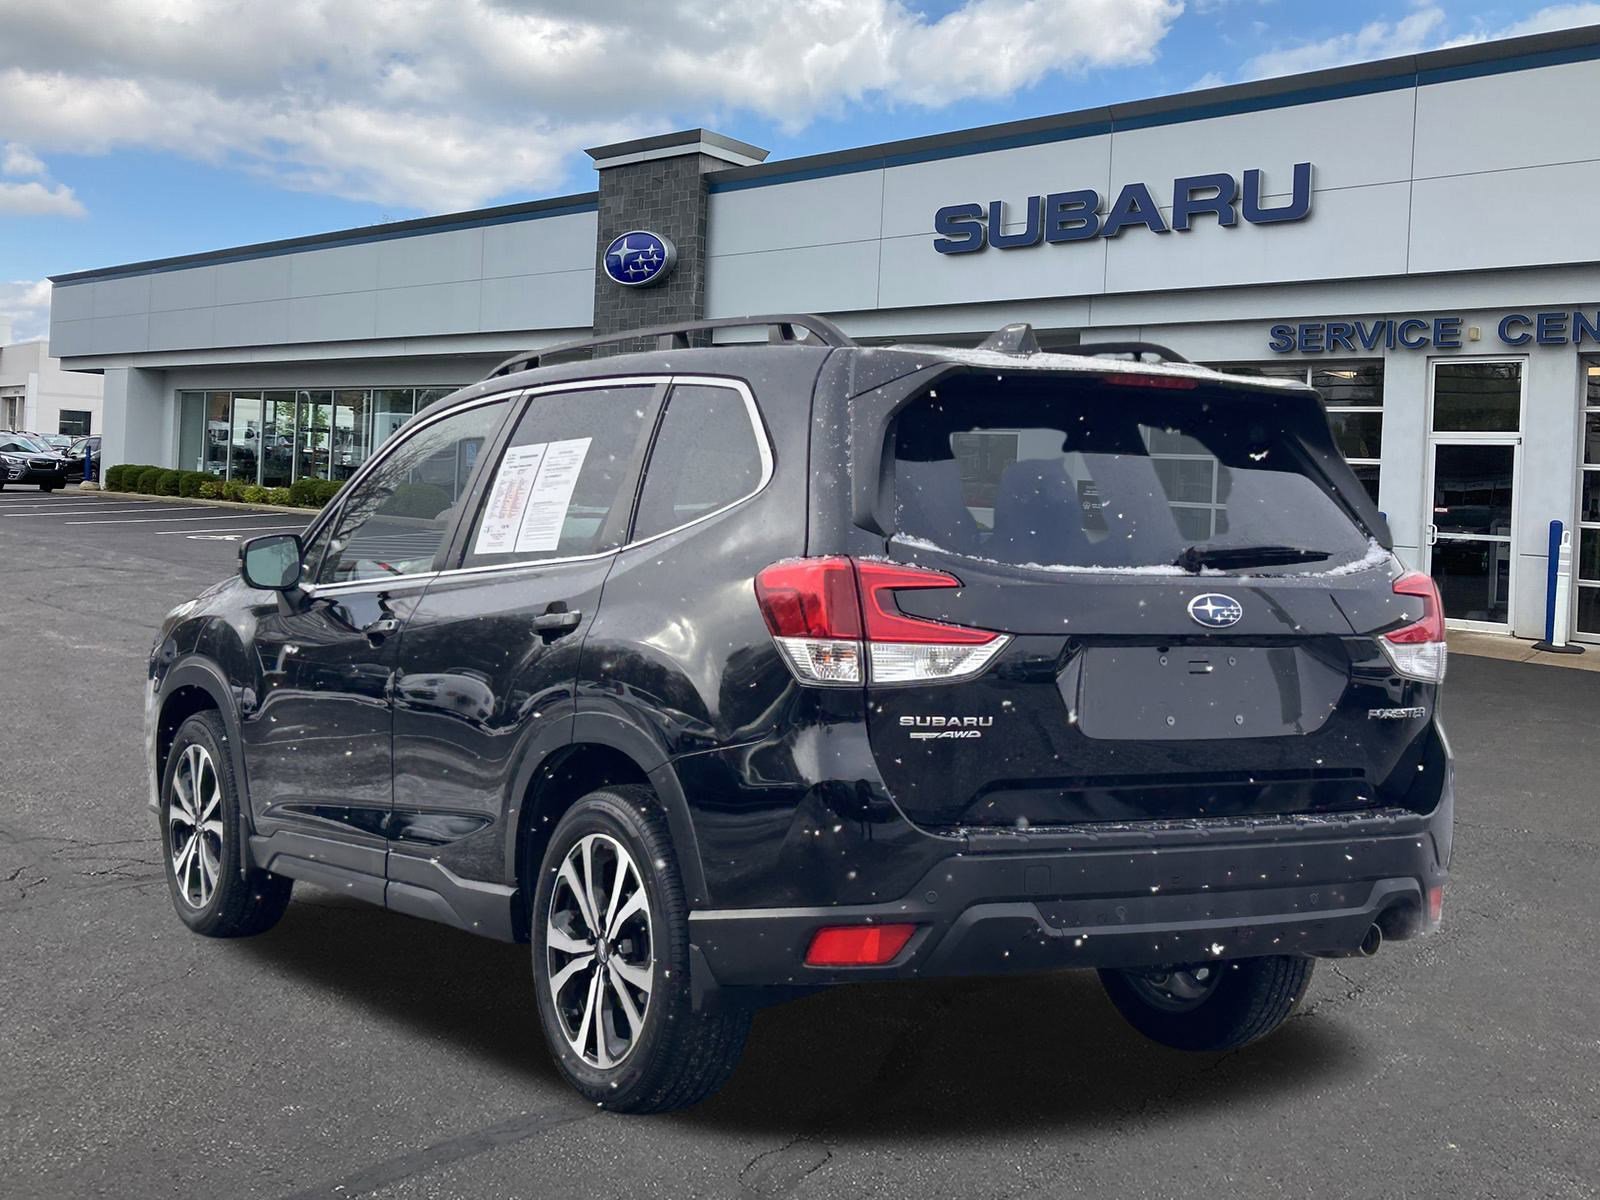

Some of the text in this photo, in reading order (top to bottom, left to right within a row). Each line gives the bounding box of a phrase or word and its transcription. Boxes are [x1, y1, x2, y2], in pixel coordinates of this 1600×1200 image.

[933, 162, 1313, 255] SUBARU
[1268, 311, 1600, 353] SERVICE CEN
[899, 716, 993, 727] SUBARU
[937, 730, 982, 739] AWD
